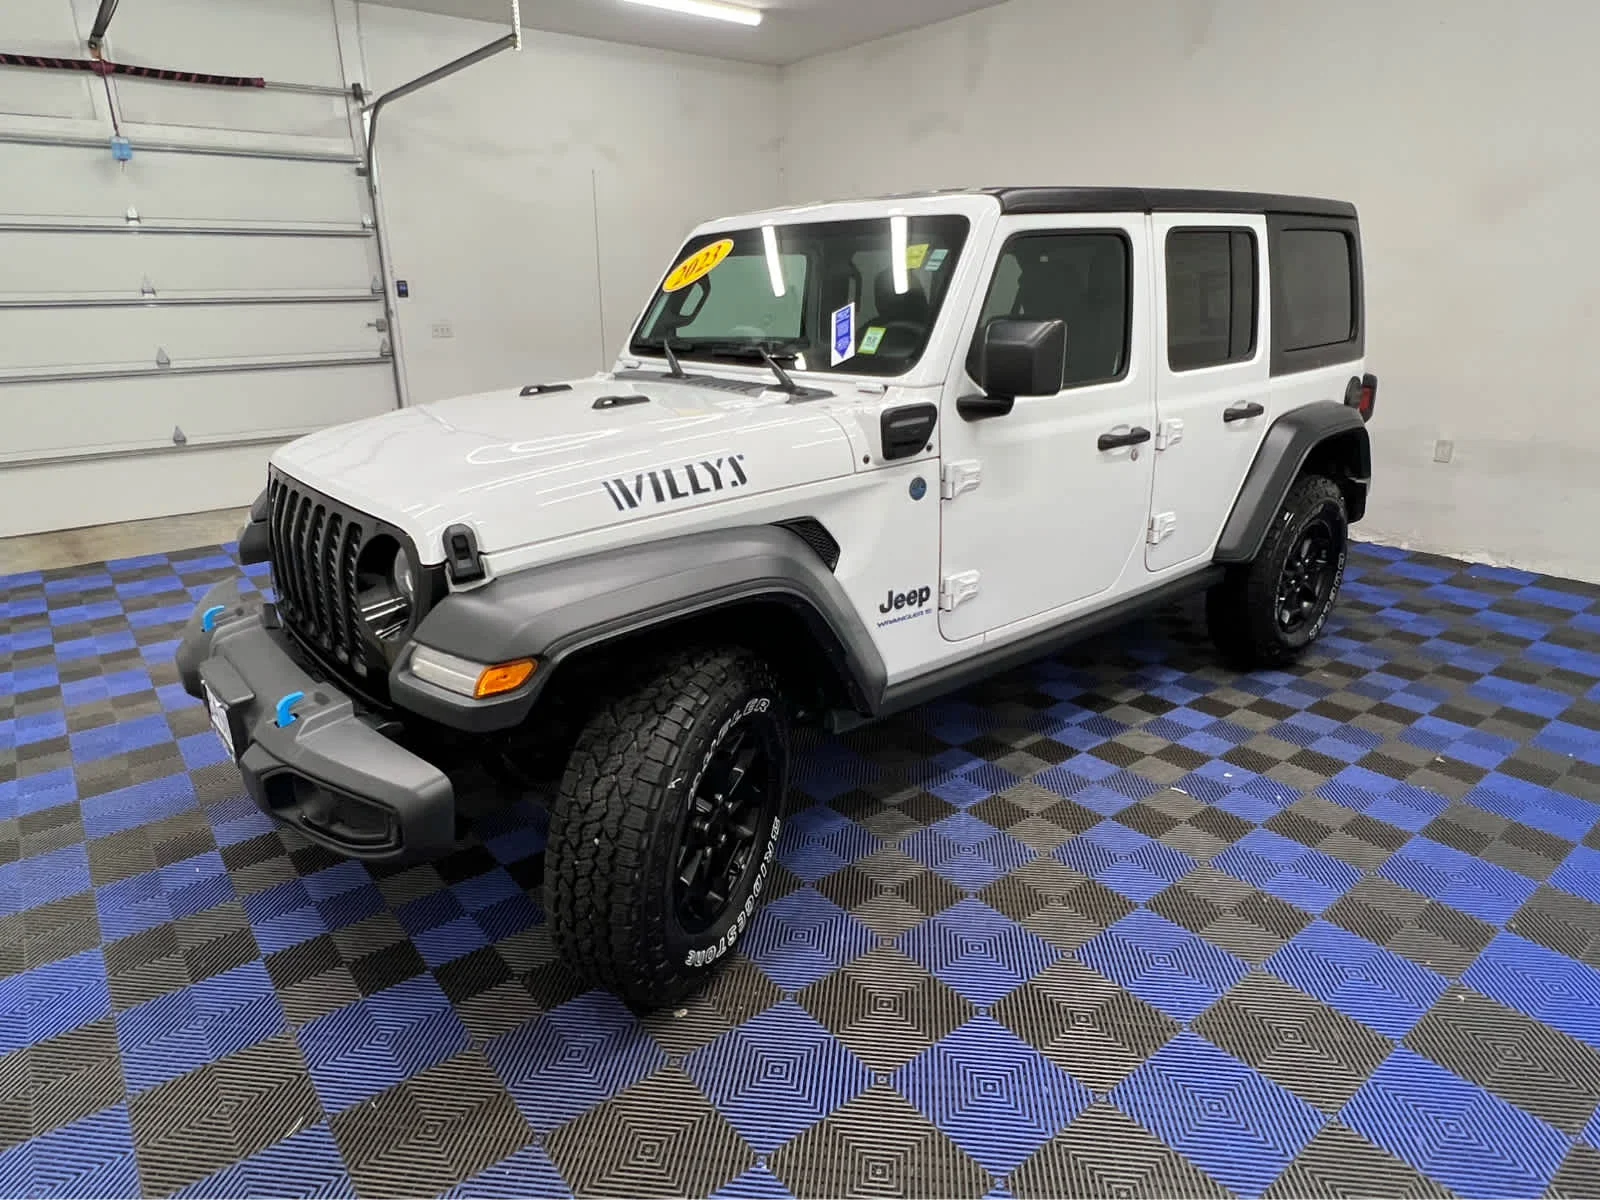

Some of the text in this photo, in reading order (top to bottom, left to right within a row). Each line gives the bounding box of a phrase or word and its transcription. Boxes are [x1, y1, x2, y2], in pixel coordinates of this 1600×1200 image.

[670, 243, 724, 288] 2023
[601, 454, 748, 511] WILLYS
[879, 585, 931, 614] Jeep
[684, 815, 781, 967] BRIDGESTONE
